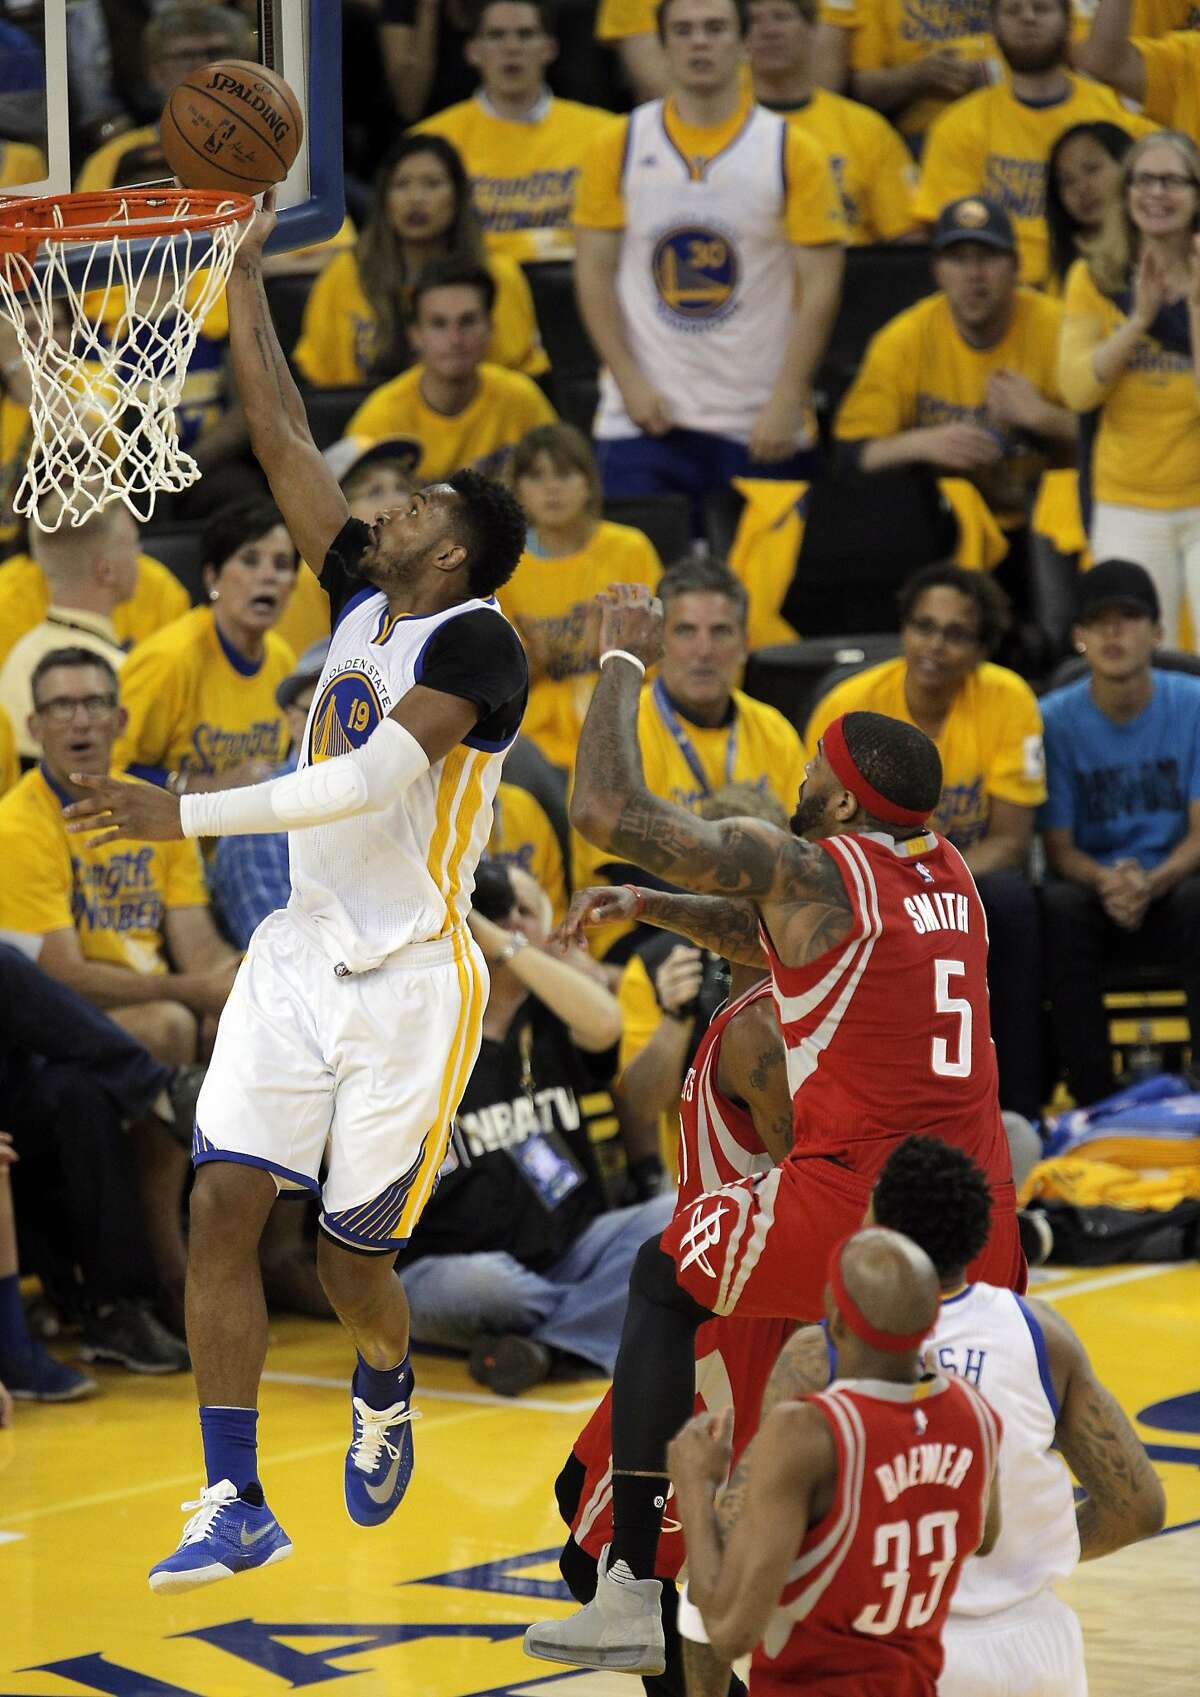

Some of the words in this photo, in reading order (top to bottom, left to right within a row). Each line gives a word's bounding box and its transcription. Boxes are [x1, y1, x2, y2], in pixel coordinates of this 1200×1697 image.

[206, 72, 290, 143] SPALDING
[322, 658, 367, 688] GOLDEN
[367, 665, 392, 709] STATE
[347, 698, 370, 732] 19
[903, 892, 970, 935] SMITH
[932, 958, 973, 1078] 5
[874, 1443, 974, 1504] BREWER
[852, 1510, 960, 1637] 33
